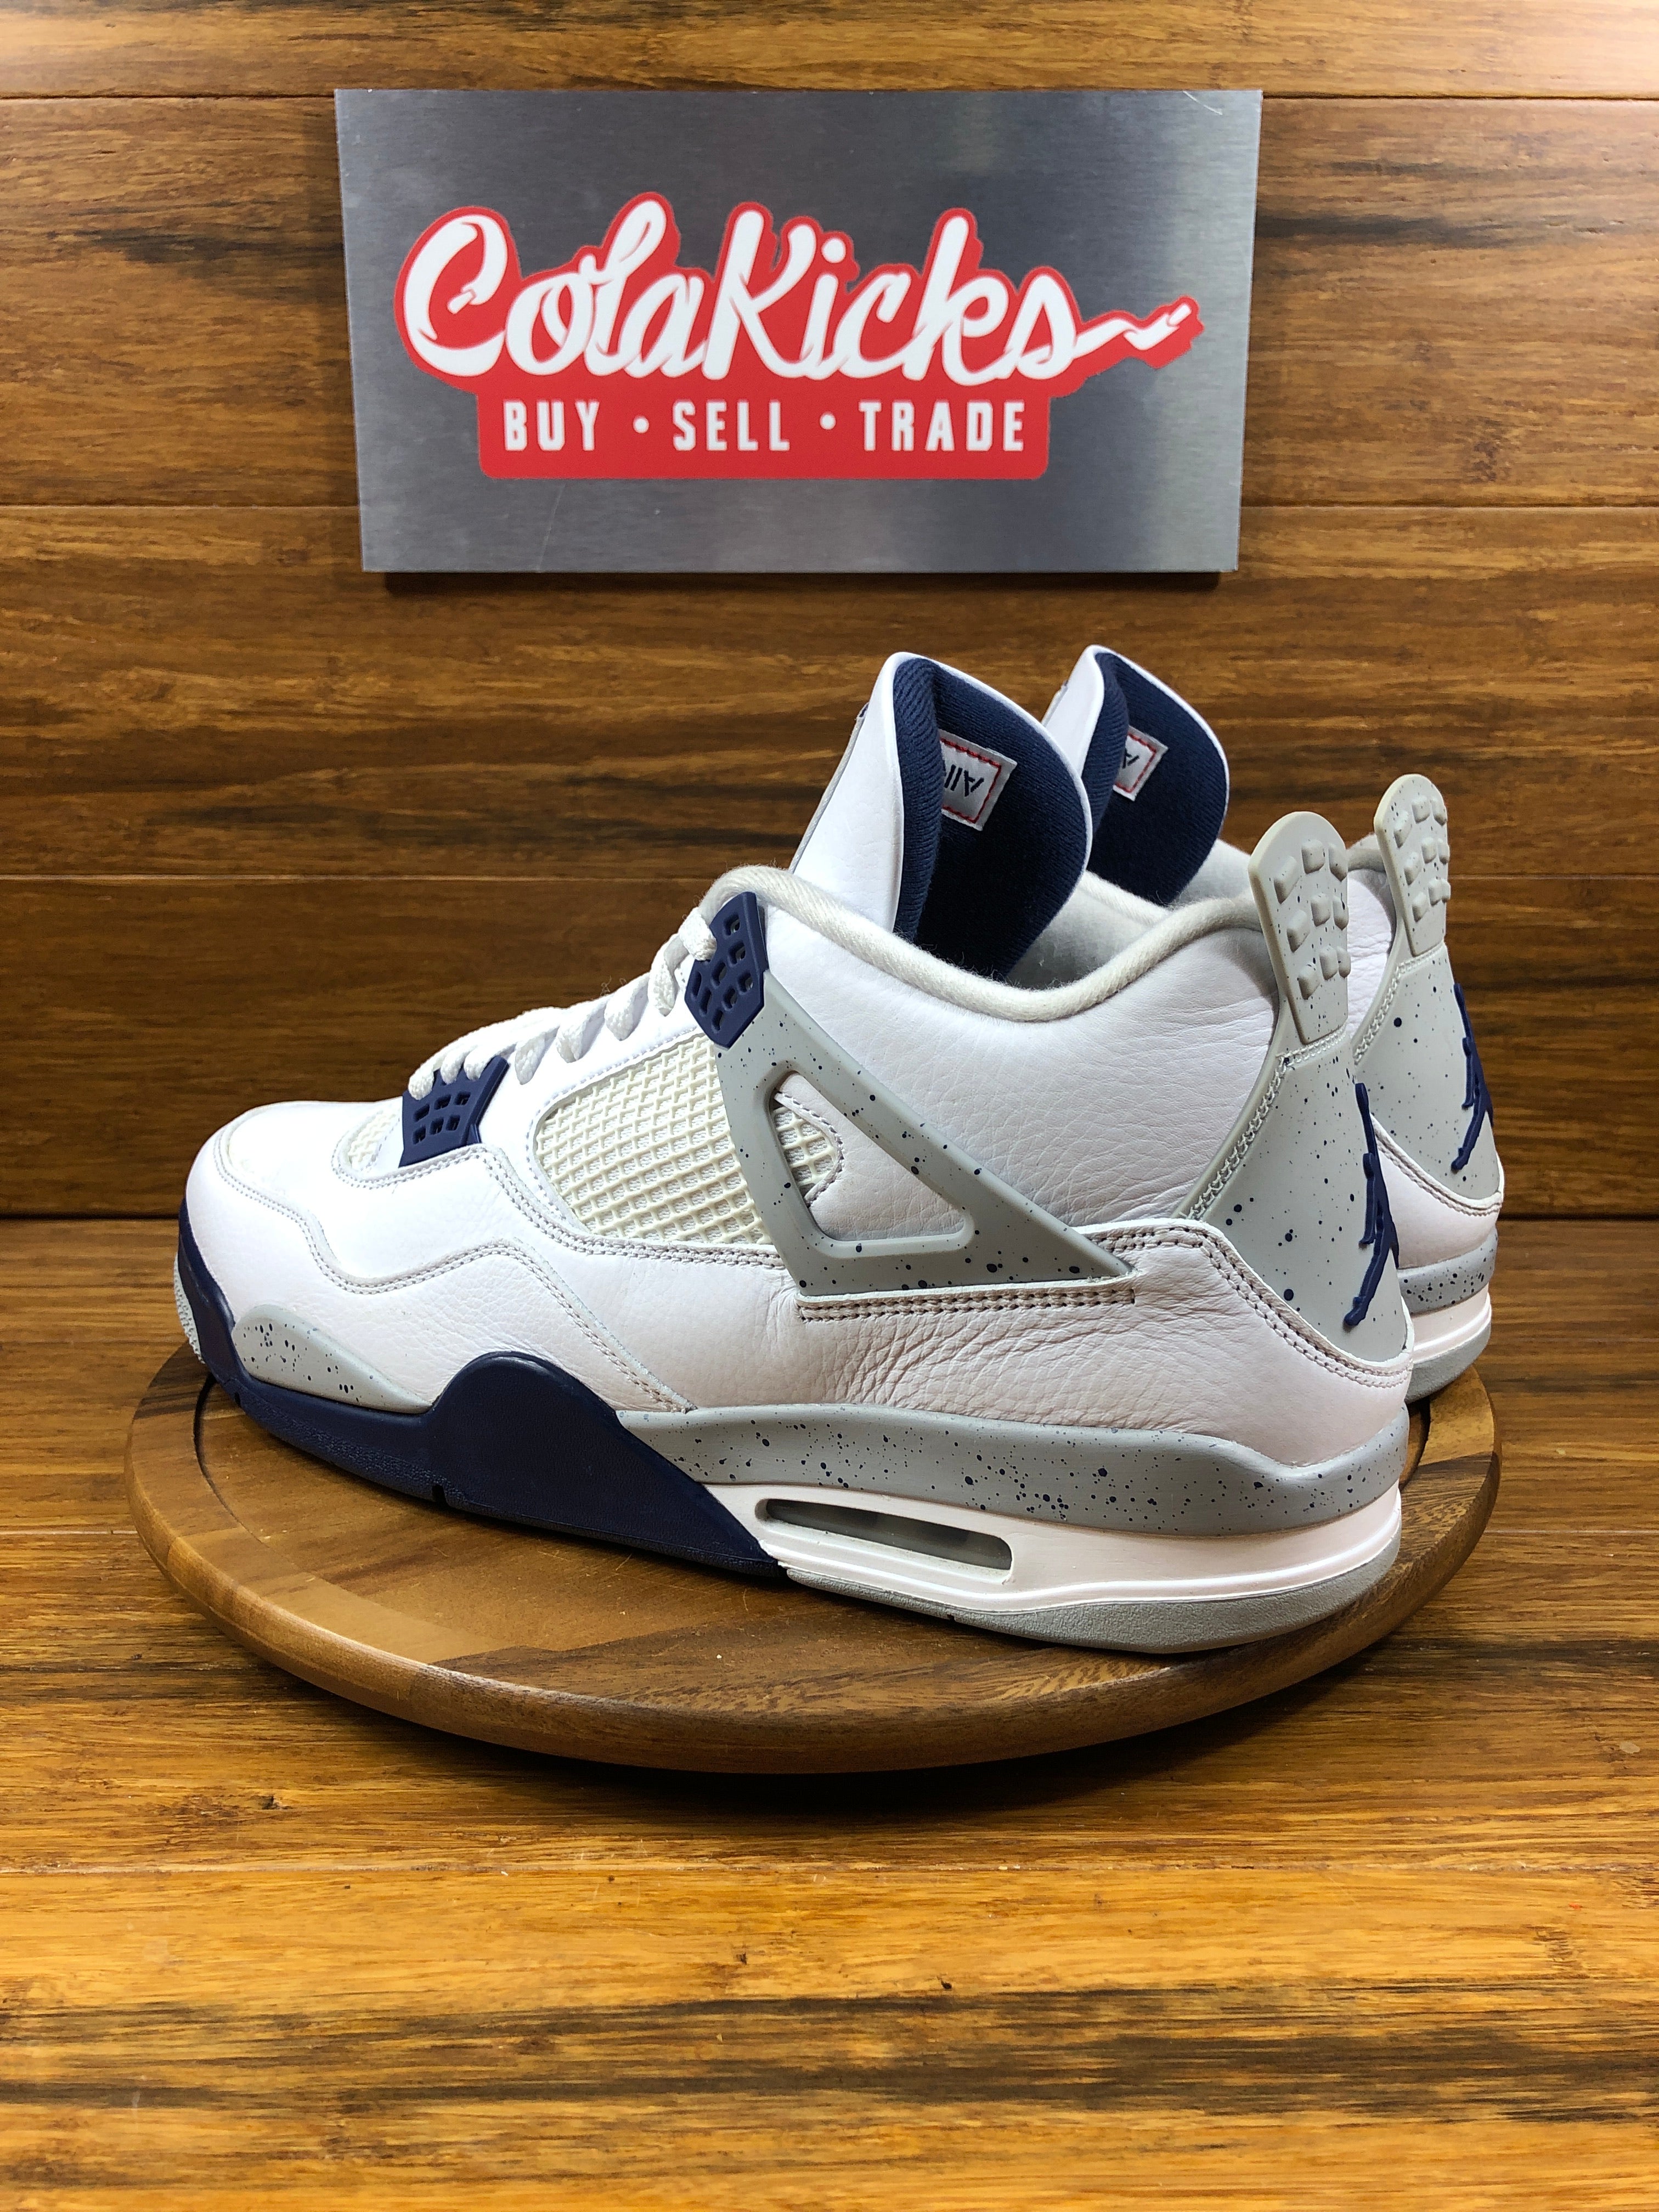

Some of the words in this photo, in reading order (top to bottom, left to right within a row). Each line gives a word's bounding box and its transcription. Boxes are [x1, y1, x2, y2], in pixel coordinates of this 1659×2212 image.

[503, 400, 600, 452] BUY
[673, 401, 790, 452] SELL
[859, 401, 1025, 452] TRADE
